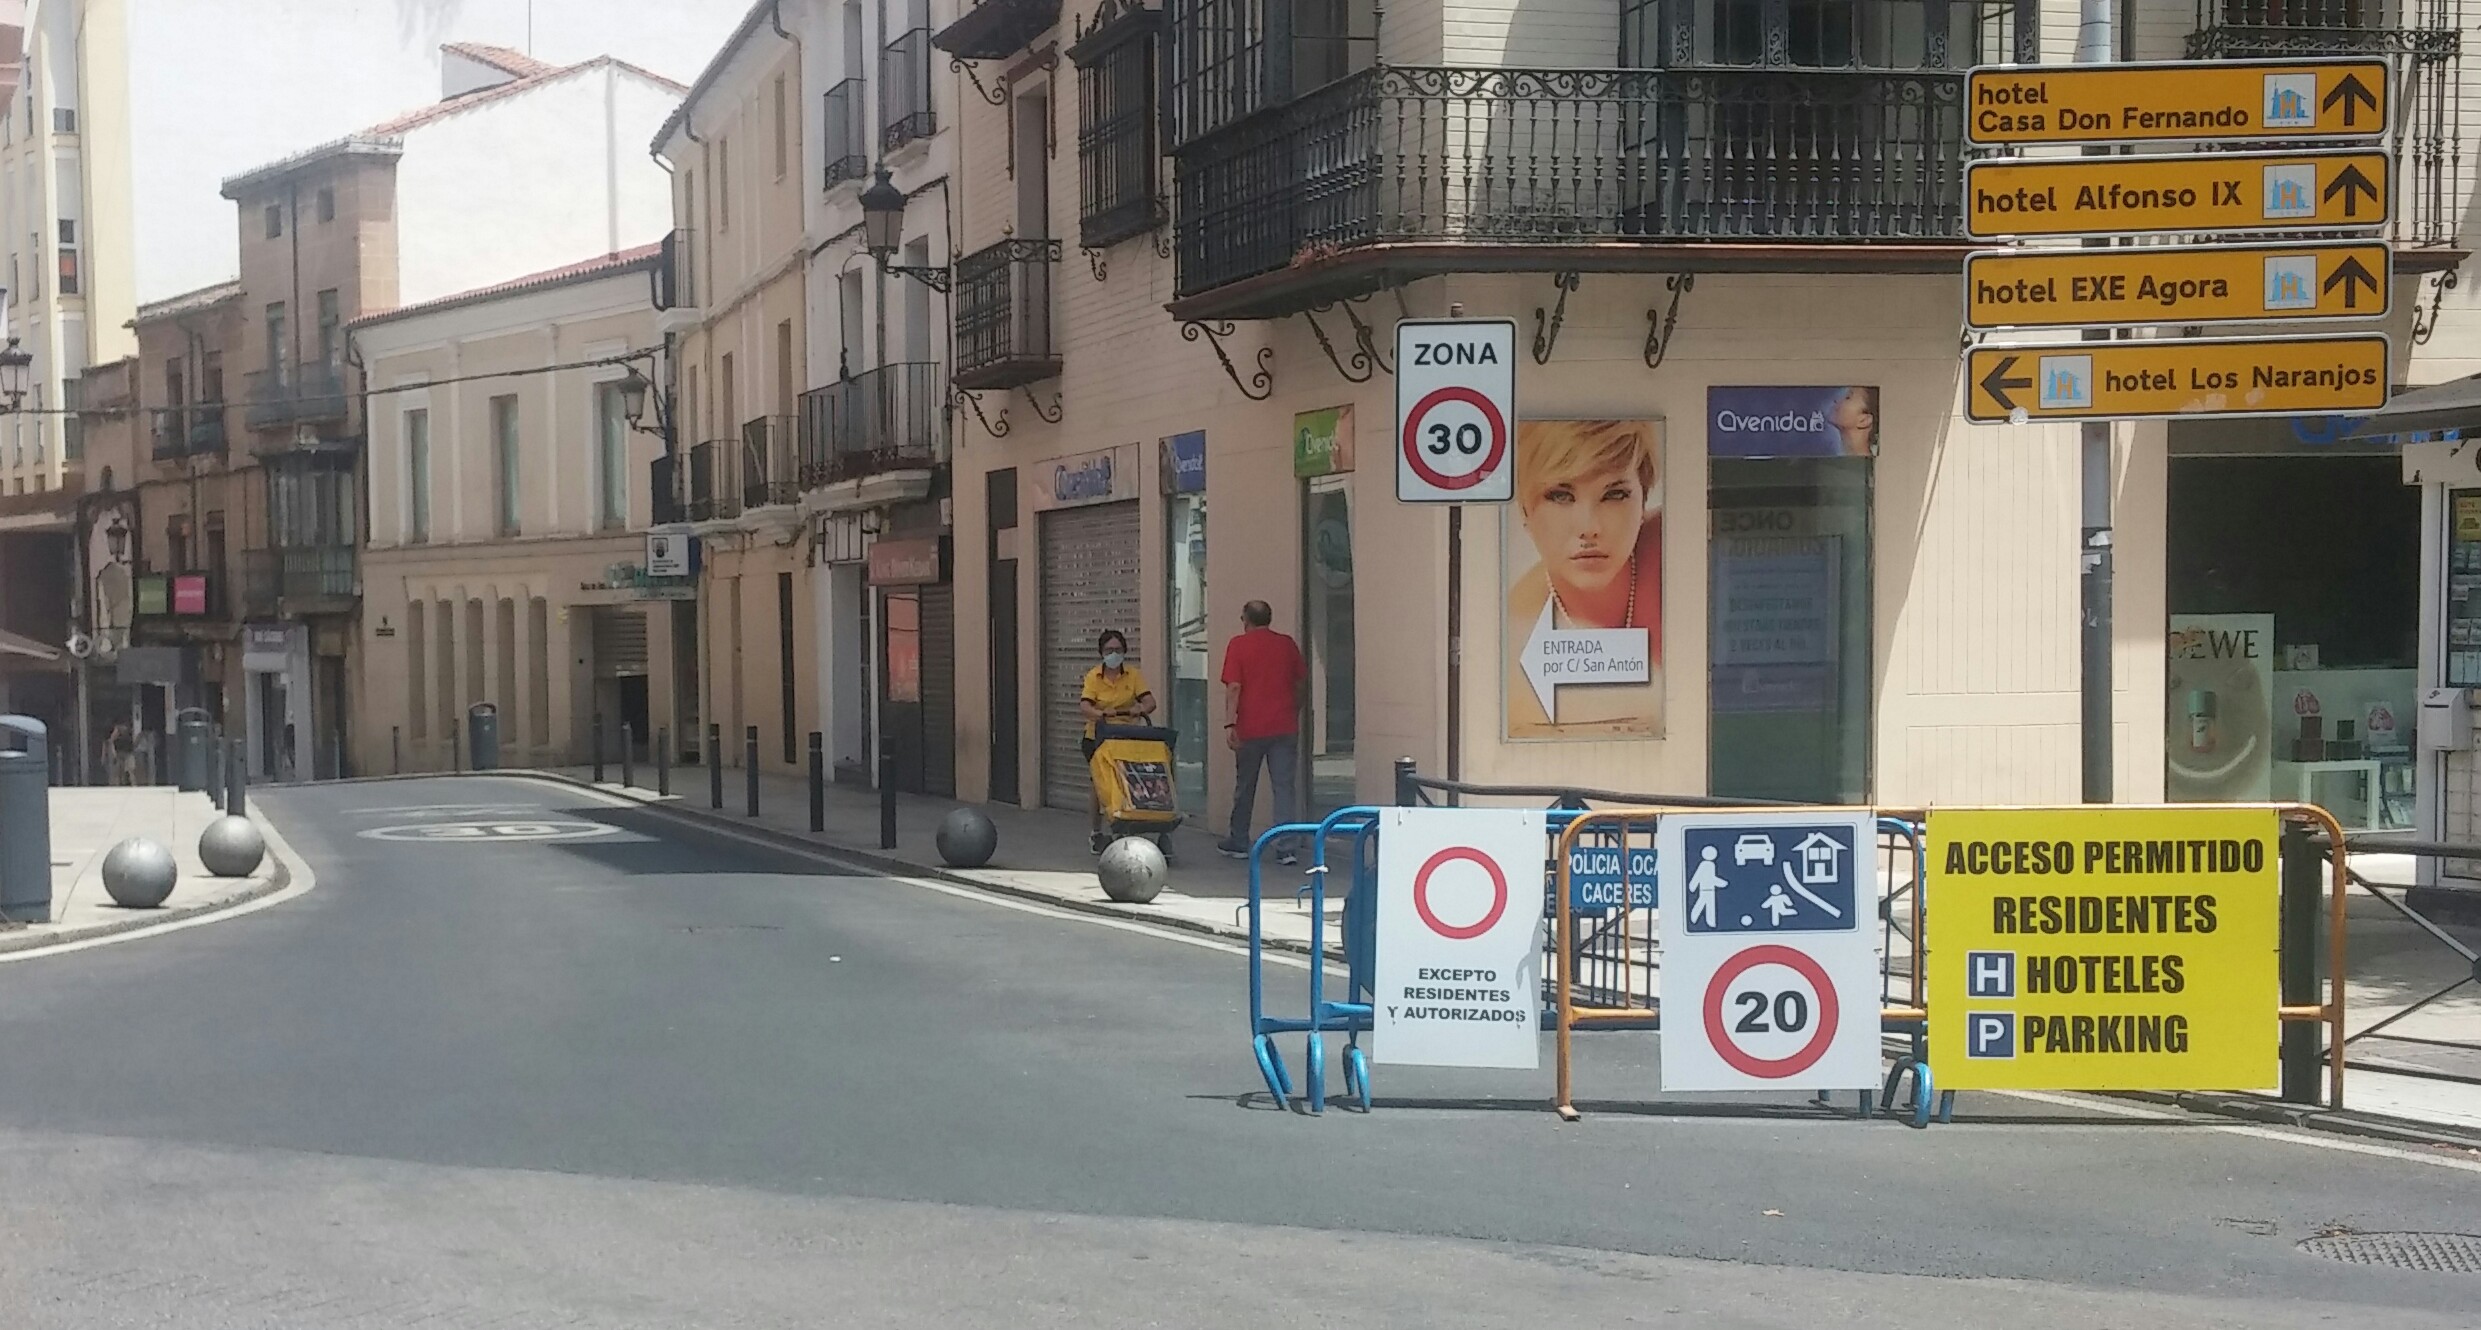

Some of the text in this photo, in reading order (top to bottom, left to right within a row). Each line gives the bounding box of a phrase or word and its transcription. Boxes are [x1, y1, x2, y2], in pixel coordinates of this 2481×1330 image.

[1977, 82, 2048, 106] hotel
[1977, 106, 2249, 132] Casa Don Fernando
[1977, 181, 2243, 213] hotel Alfonso IX
[1977, 275, 2229, 306] hotel EXE Agora
[1414, 342, 1498, 366] ZONA
[2105, 364, 2377, 393] hotel Los Naranjos
[1427, 422, 1483, 455] 30
[1543, 640, 1604, 655] ENTRADA
[1543, 657, 1644, 676] por C/ San Antón
[1945, 839, 2264, 875] ACCESO PERMITIDO
[1993, 895, 2217, 934] RESIDENTES
[1418, 967, 1497, 982] EXCEPTO
[1976, 955, 2185, 994] H HOTELES
[1403, 986, 1511, 1003] RESIDENTES
[1387, 1005, 1526, 1023] Y AUTORIZADOS
[1734, 990, 1808, 1034] 20
[1978, 1015, 2189, 1053] P PARKING
